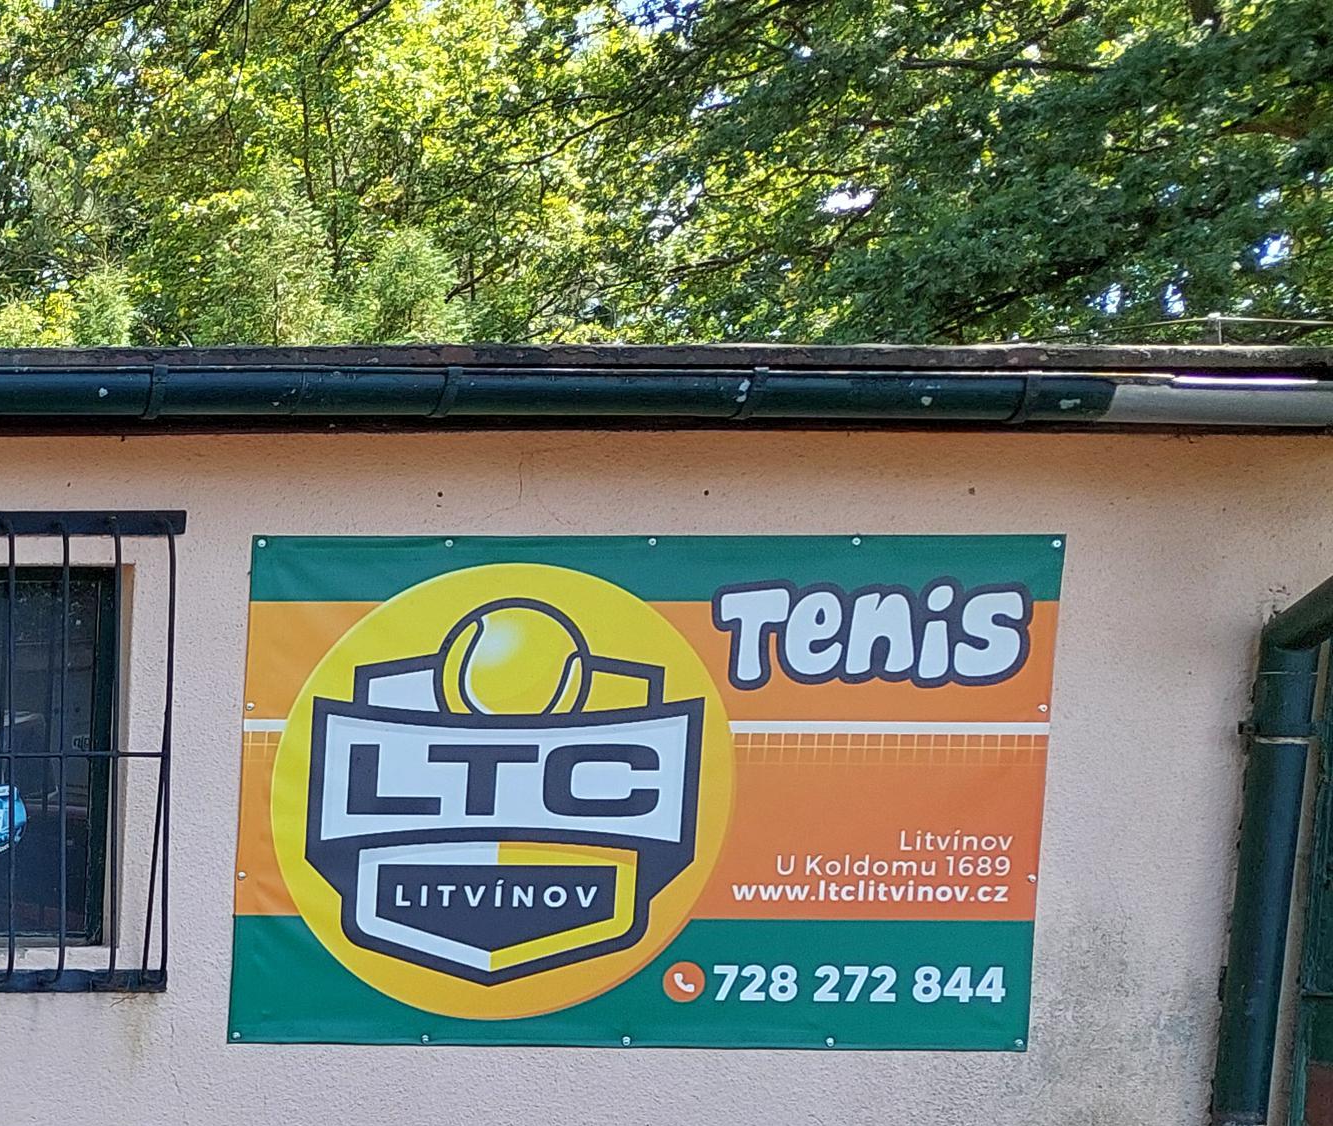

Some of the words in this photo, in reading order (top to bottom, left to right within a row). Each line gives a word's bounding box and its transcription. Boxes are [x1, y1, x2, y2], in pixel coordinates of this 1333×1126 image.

[345, 743, 662, 818] LTC
[899, 829, 1013, 851] Litvínov
[776, 855, 796, 876] U
[805, 854, 937, 876] Koldomu
[945, 855, 1011, 876] 1689
[394, 878, 601, 911] LITVÍNOV
[732, 879, 1010, 902] www.ltclitvinov.cz
[713, 964, 798, 1002] 728
[813, 964, 897, 1002] 272
[912, 965, 1006, 1004] 844
